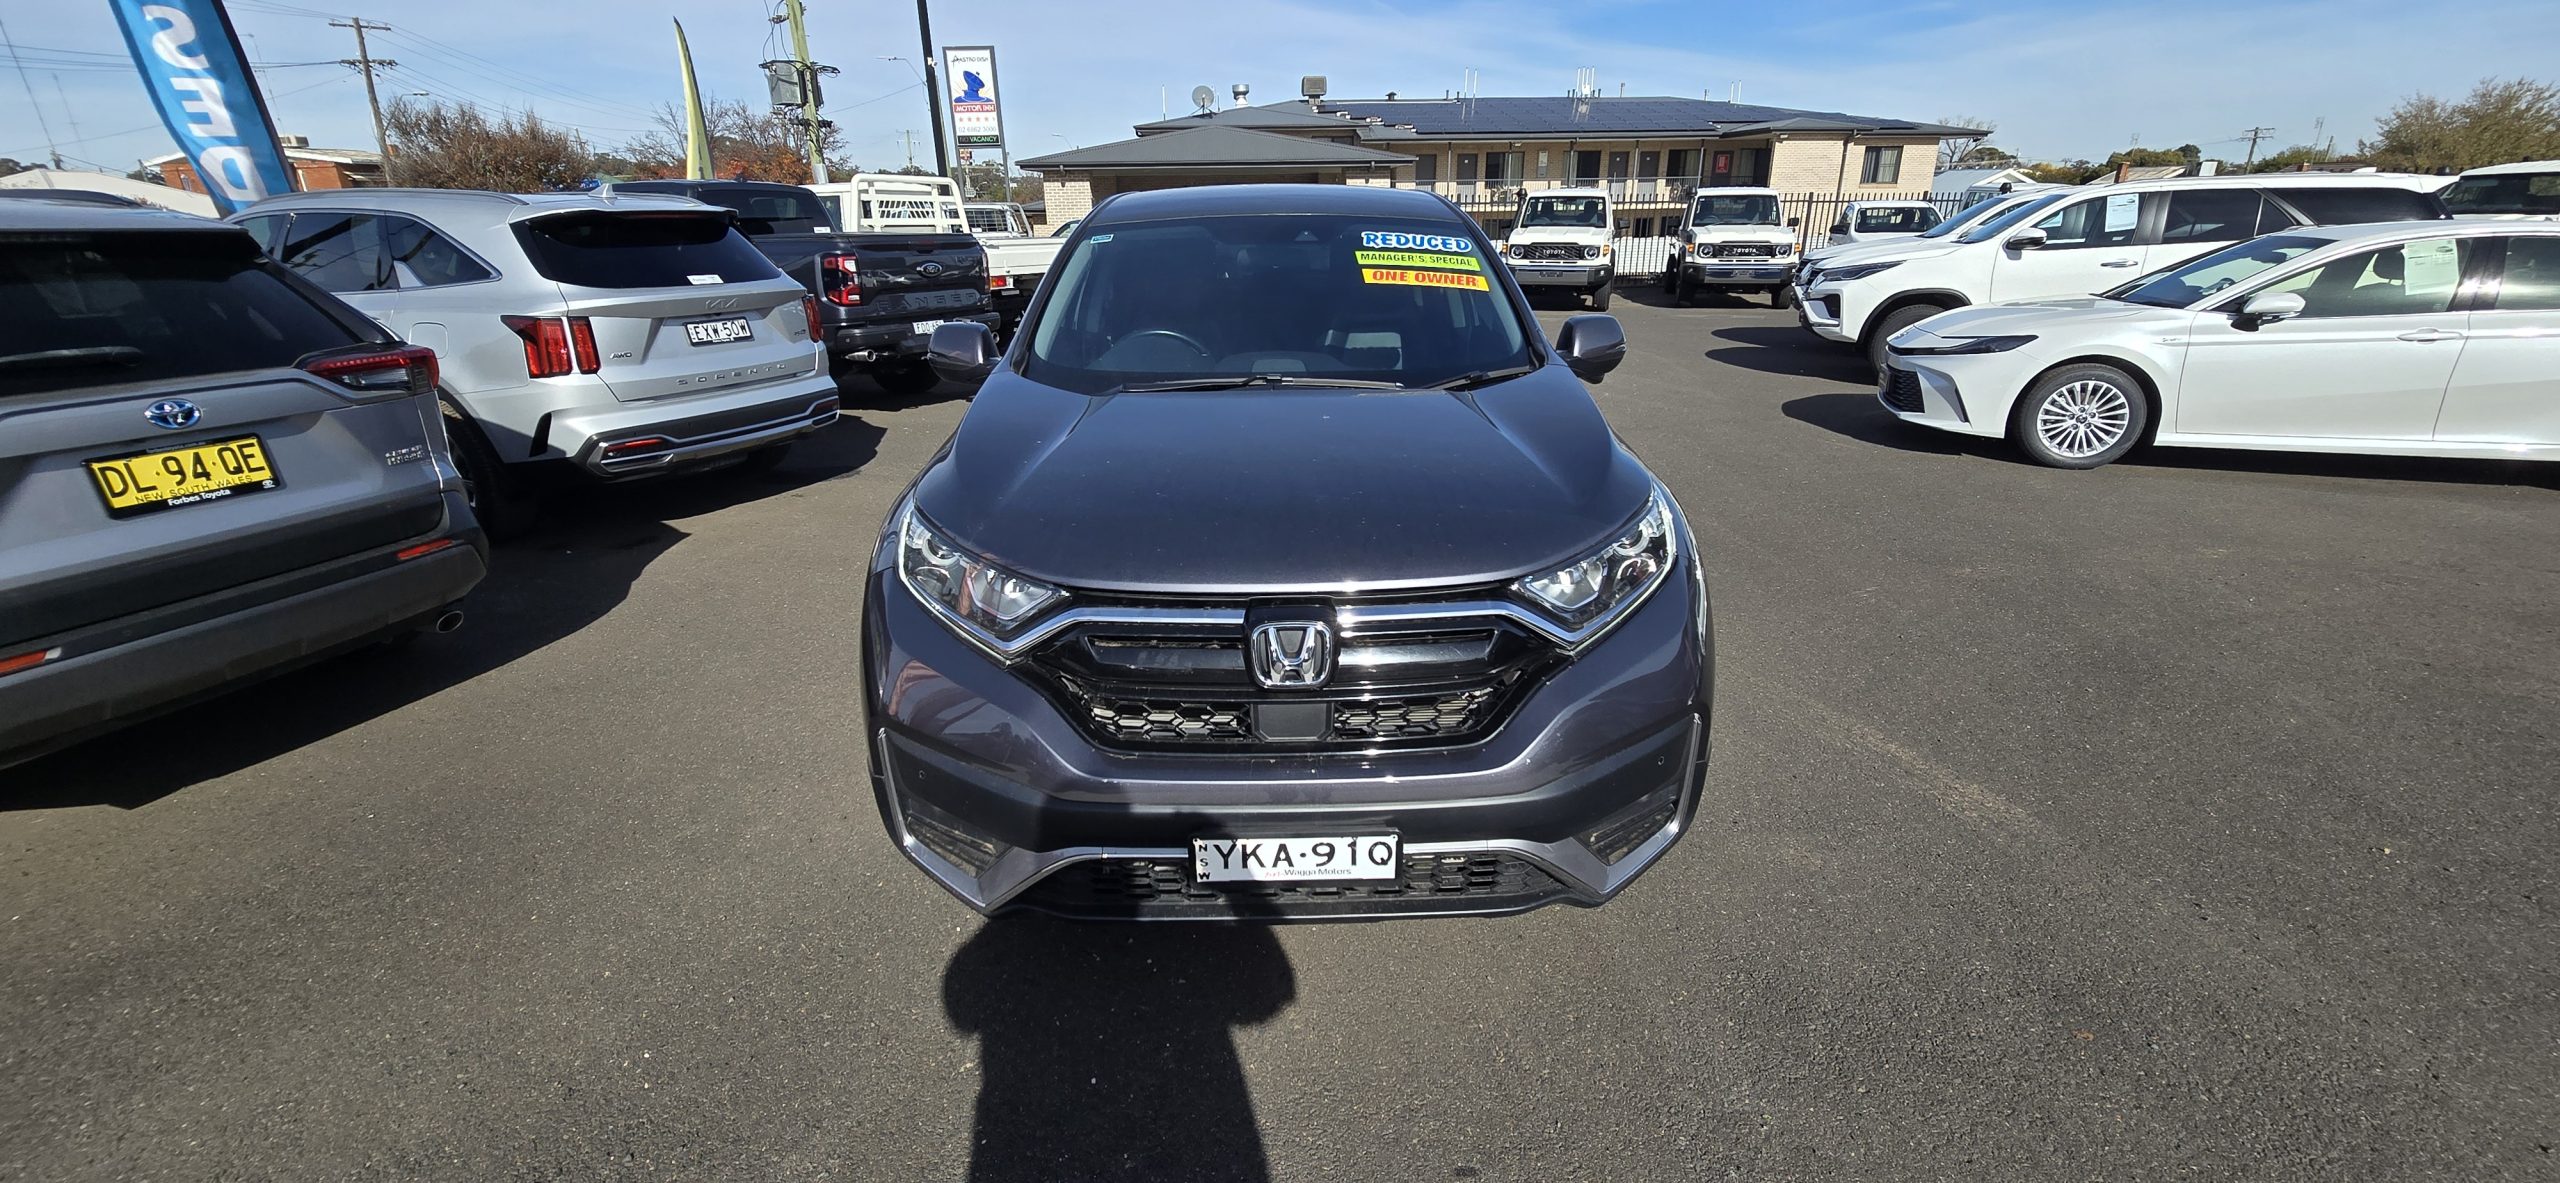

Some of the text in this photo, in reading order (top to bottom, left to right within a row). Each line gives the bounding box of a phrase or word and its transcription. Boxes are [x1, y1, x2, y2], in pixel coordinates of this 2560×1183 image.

[956, 104, 982, 112] MOTOR
[1363, 232, 1471, 251] REDUCED
[1360, 253, 1473, 266] MANAGER'S SPECIAL
[1372, 270, 1477, 287] ONE OWNER
[610, 351, 632, 359] AWD
[678, 364, 786, 386] SORENTO
[135, 475, 253, 504] NEW SOUTH WALES
[167, 488, 231, 507] Forbes Toyota
